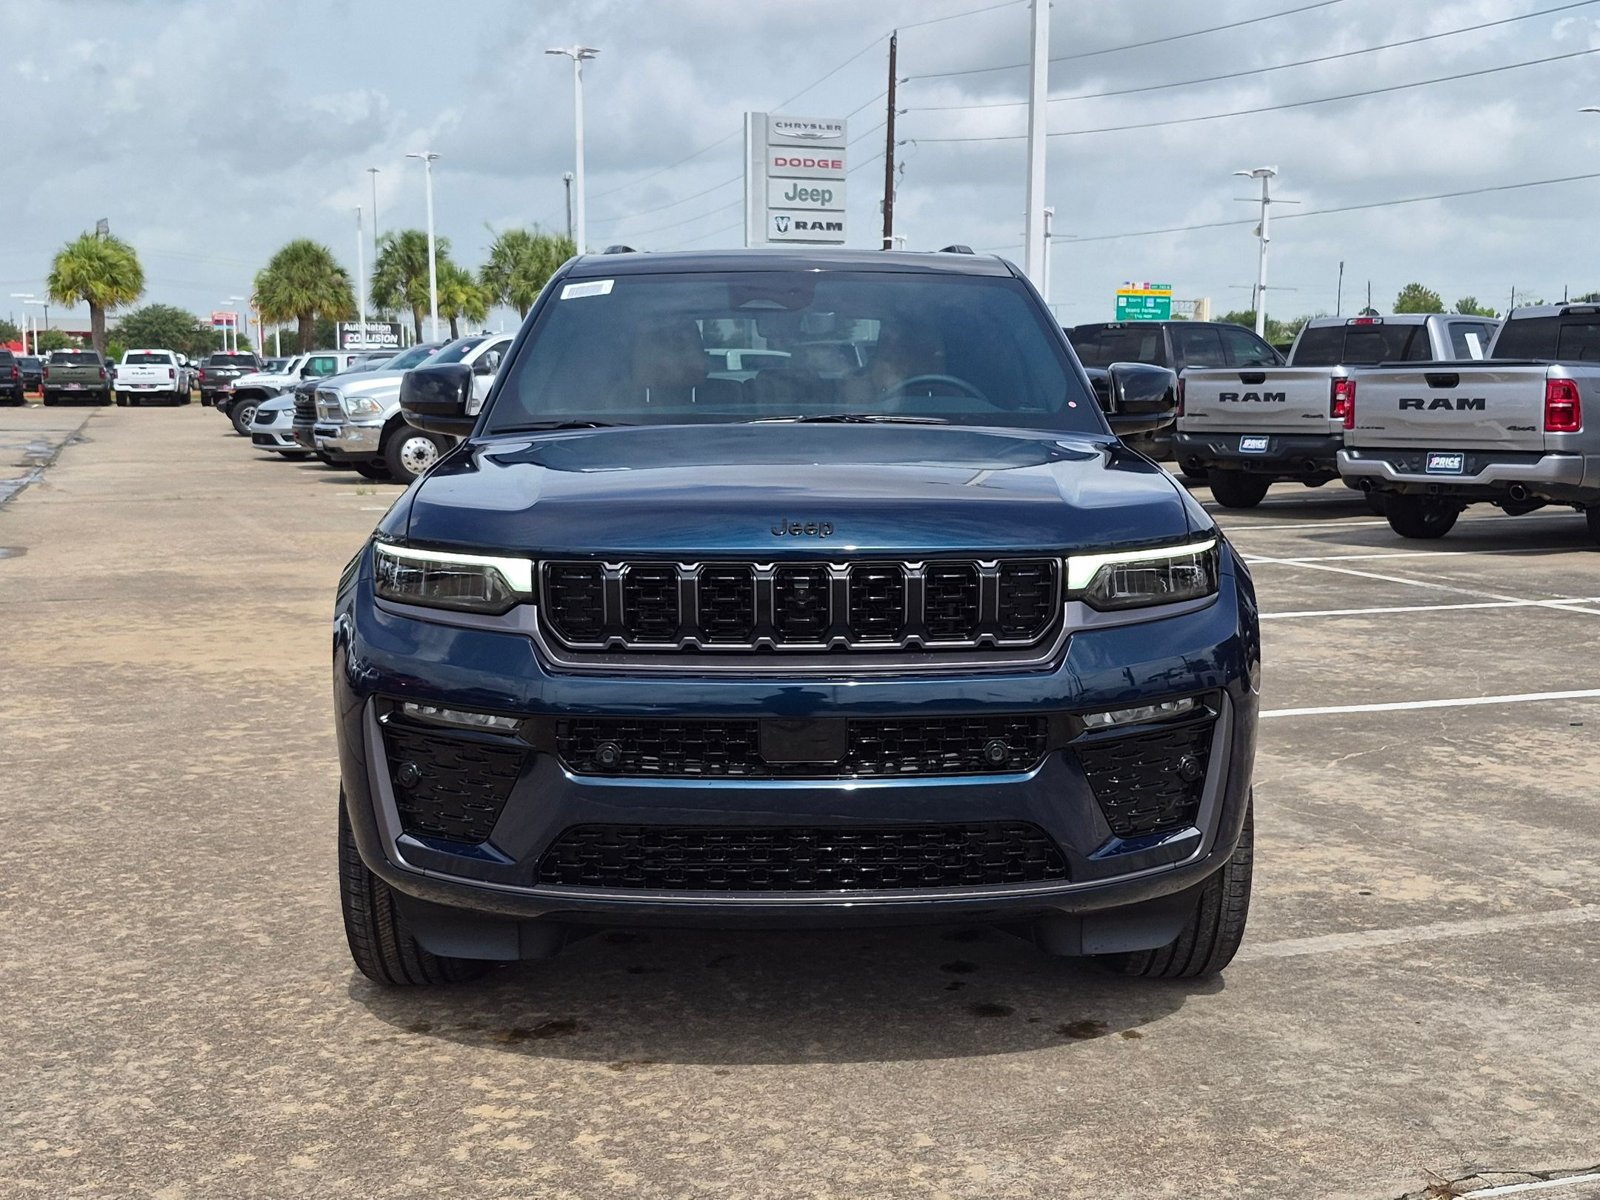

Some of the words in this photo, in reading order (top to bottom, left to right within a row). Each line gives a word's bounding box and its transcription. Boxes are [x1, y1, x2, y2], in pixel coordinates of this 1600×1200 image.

[775, 122, 842, 131] CHRYSLER
[774, 157, 843, 169] DODGE
[784, 182, 833, 206] Jeep
[795, 221, 843, 231] RAM
[343, 322, 391, 332] AutNation
[347, 332, 398, 344] COLISION
[1219, 392, 1286, 402] RAM
[1399, 398, 1486, 410] RAM
[771, 519, 834, 538] Jeep
